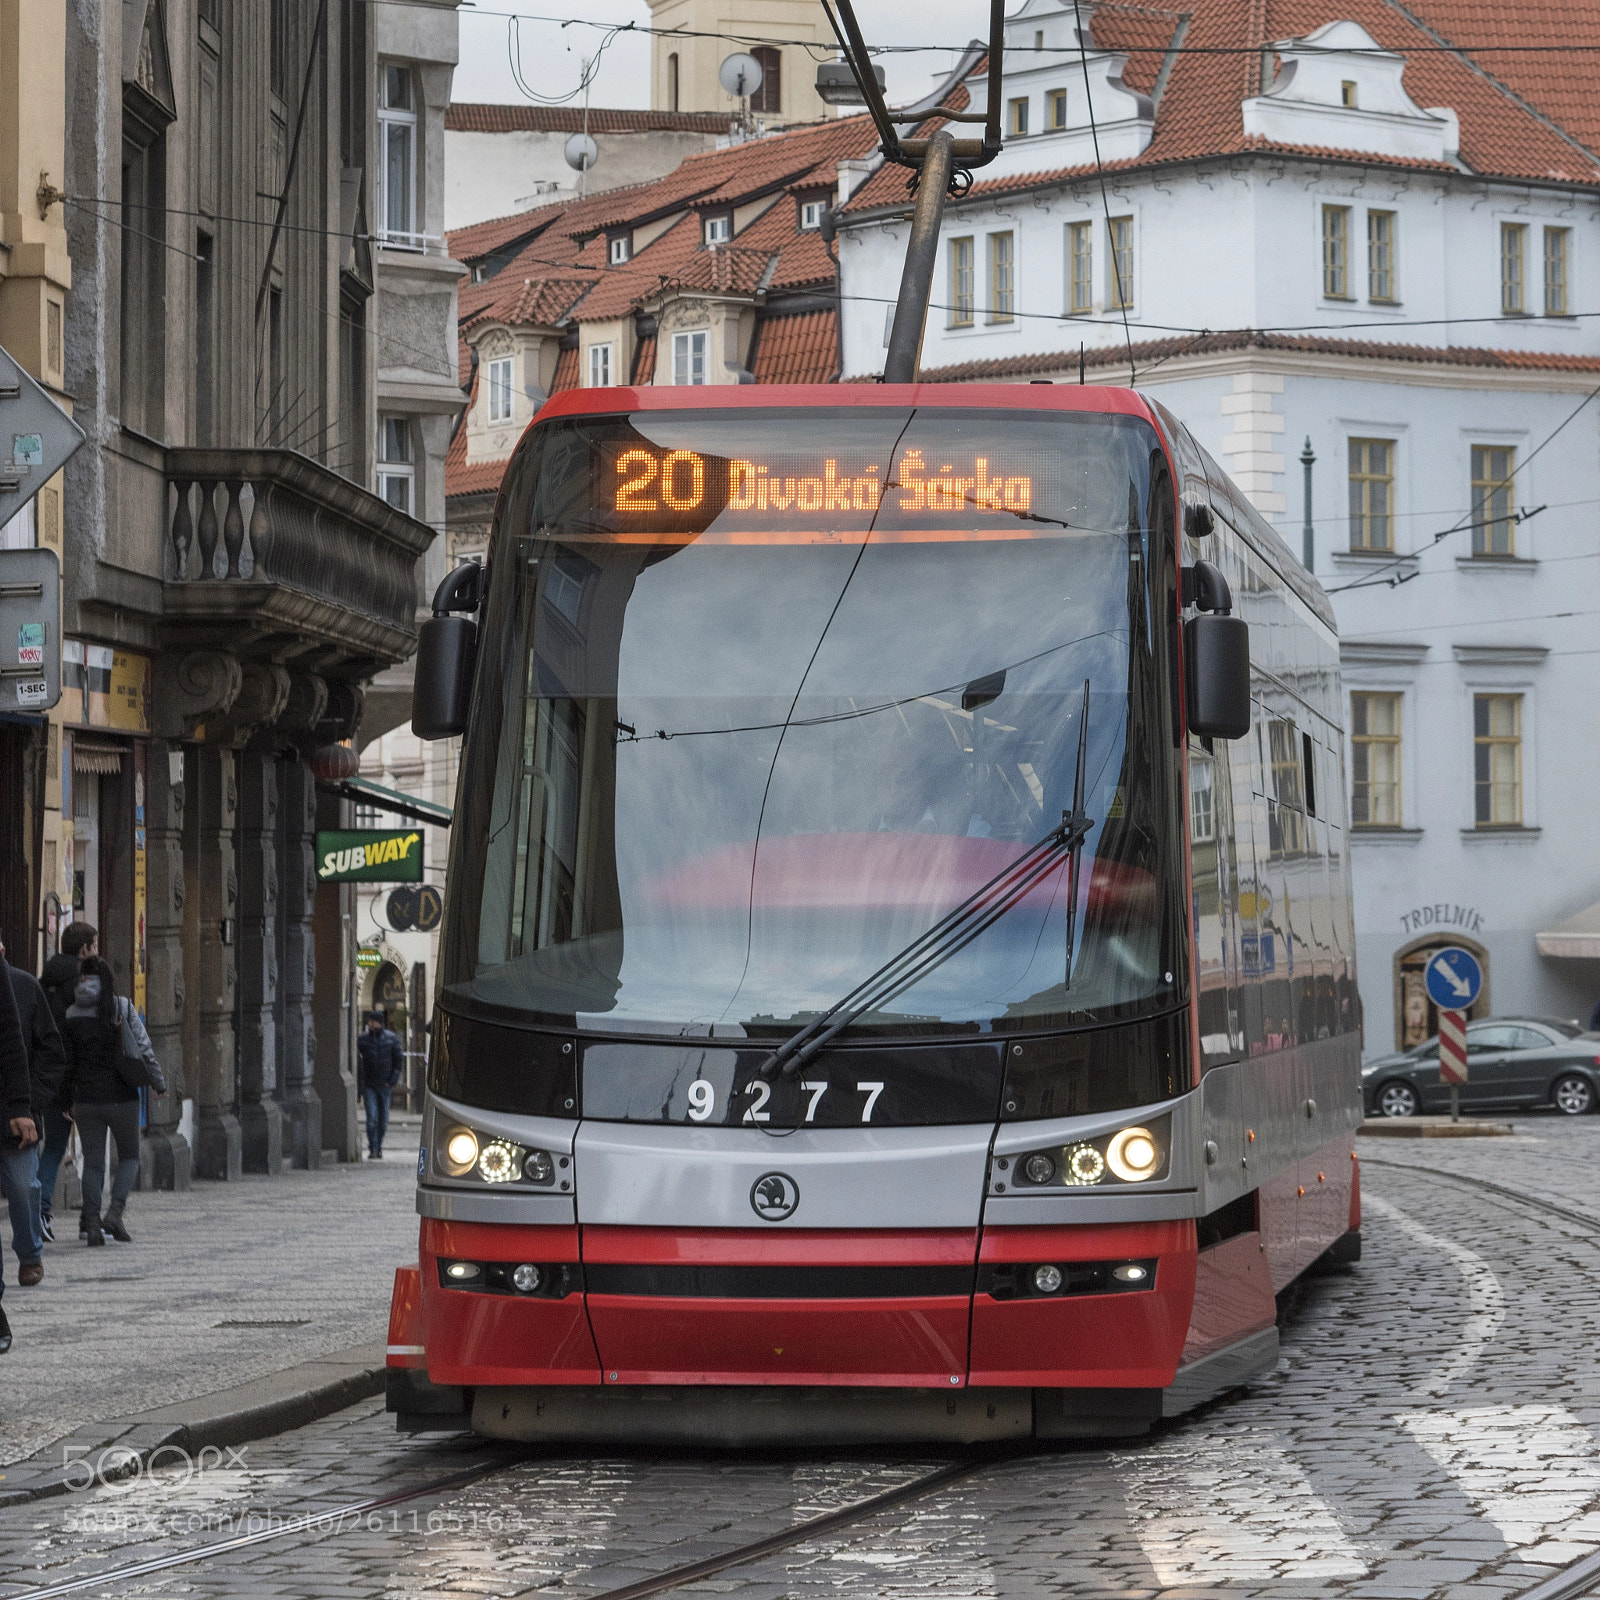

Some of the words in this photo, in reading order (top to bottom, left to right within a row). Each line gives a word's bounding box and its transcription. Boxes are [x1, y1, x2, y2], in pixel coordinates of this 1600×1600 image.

[616, 450, 704, 511] 20
[730, 459, 878, 511] Divoká
[899, 450, 1031, 510] Šárka
[19, 684, 46, 695] 1-SEC
[318, 833, 419, 878] SUBWAY
[1401, 903, 1485, 933] TRDELNÍK
